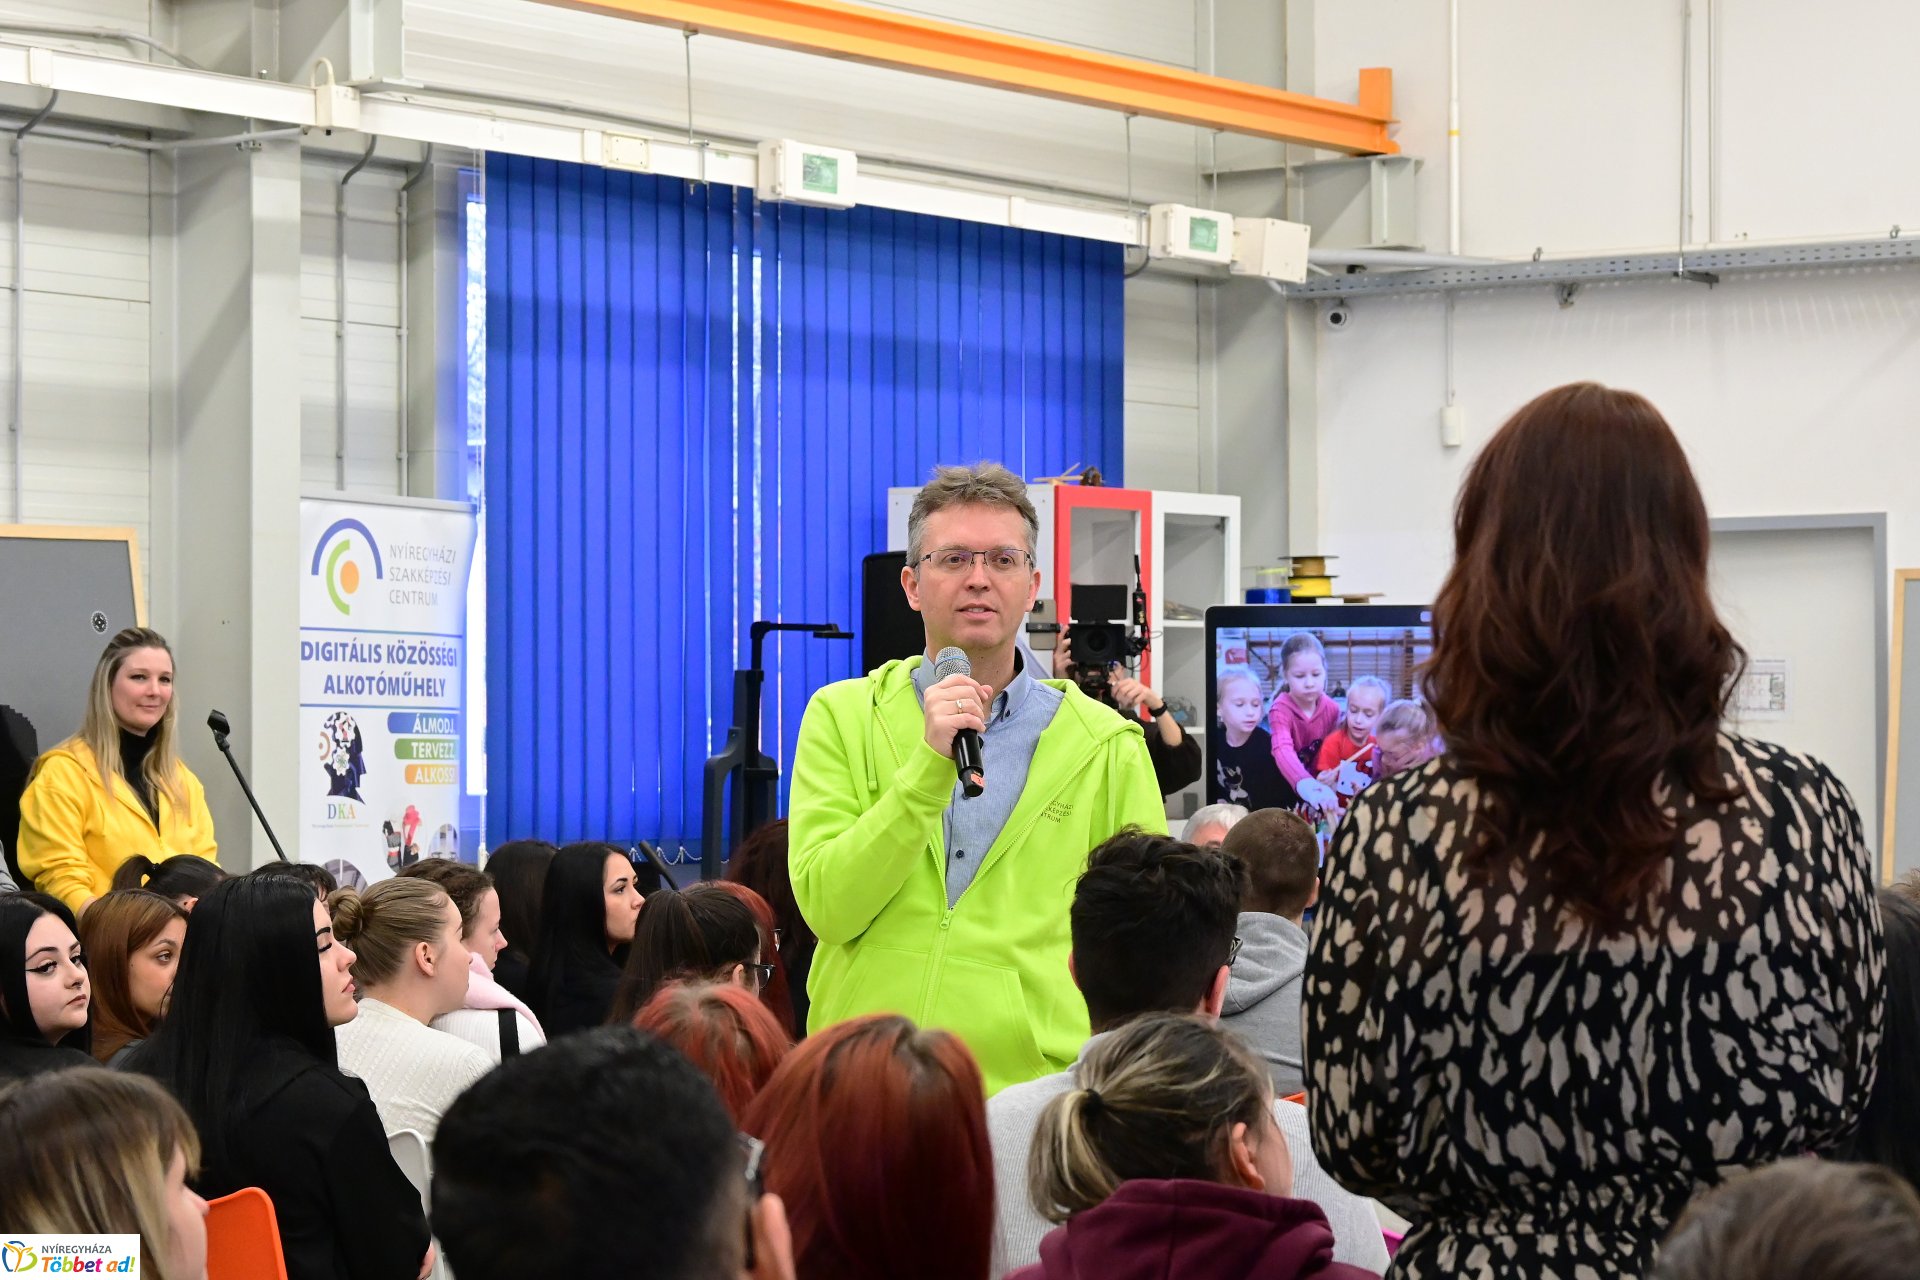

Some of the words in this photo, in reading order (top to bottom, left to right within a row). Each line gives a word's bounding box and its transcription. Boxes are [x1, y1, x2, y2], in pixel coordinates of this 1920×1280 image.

[389, 589, 438, 606] CENTRUM
[300, 637, 382, 664] DIGITÁLIS
[386, 639, 457, 667] KÖZÖSSÉGI
[323, 670, 446, 697] ALKOTÓMŰHELY
[327, 803, 356, 820] DKA
